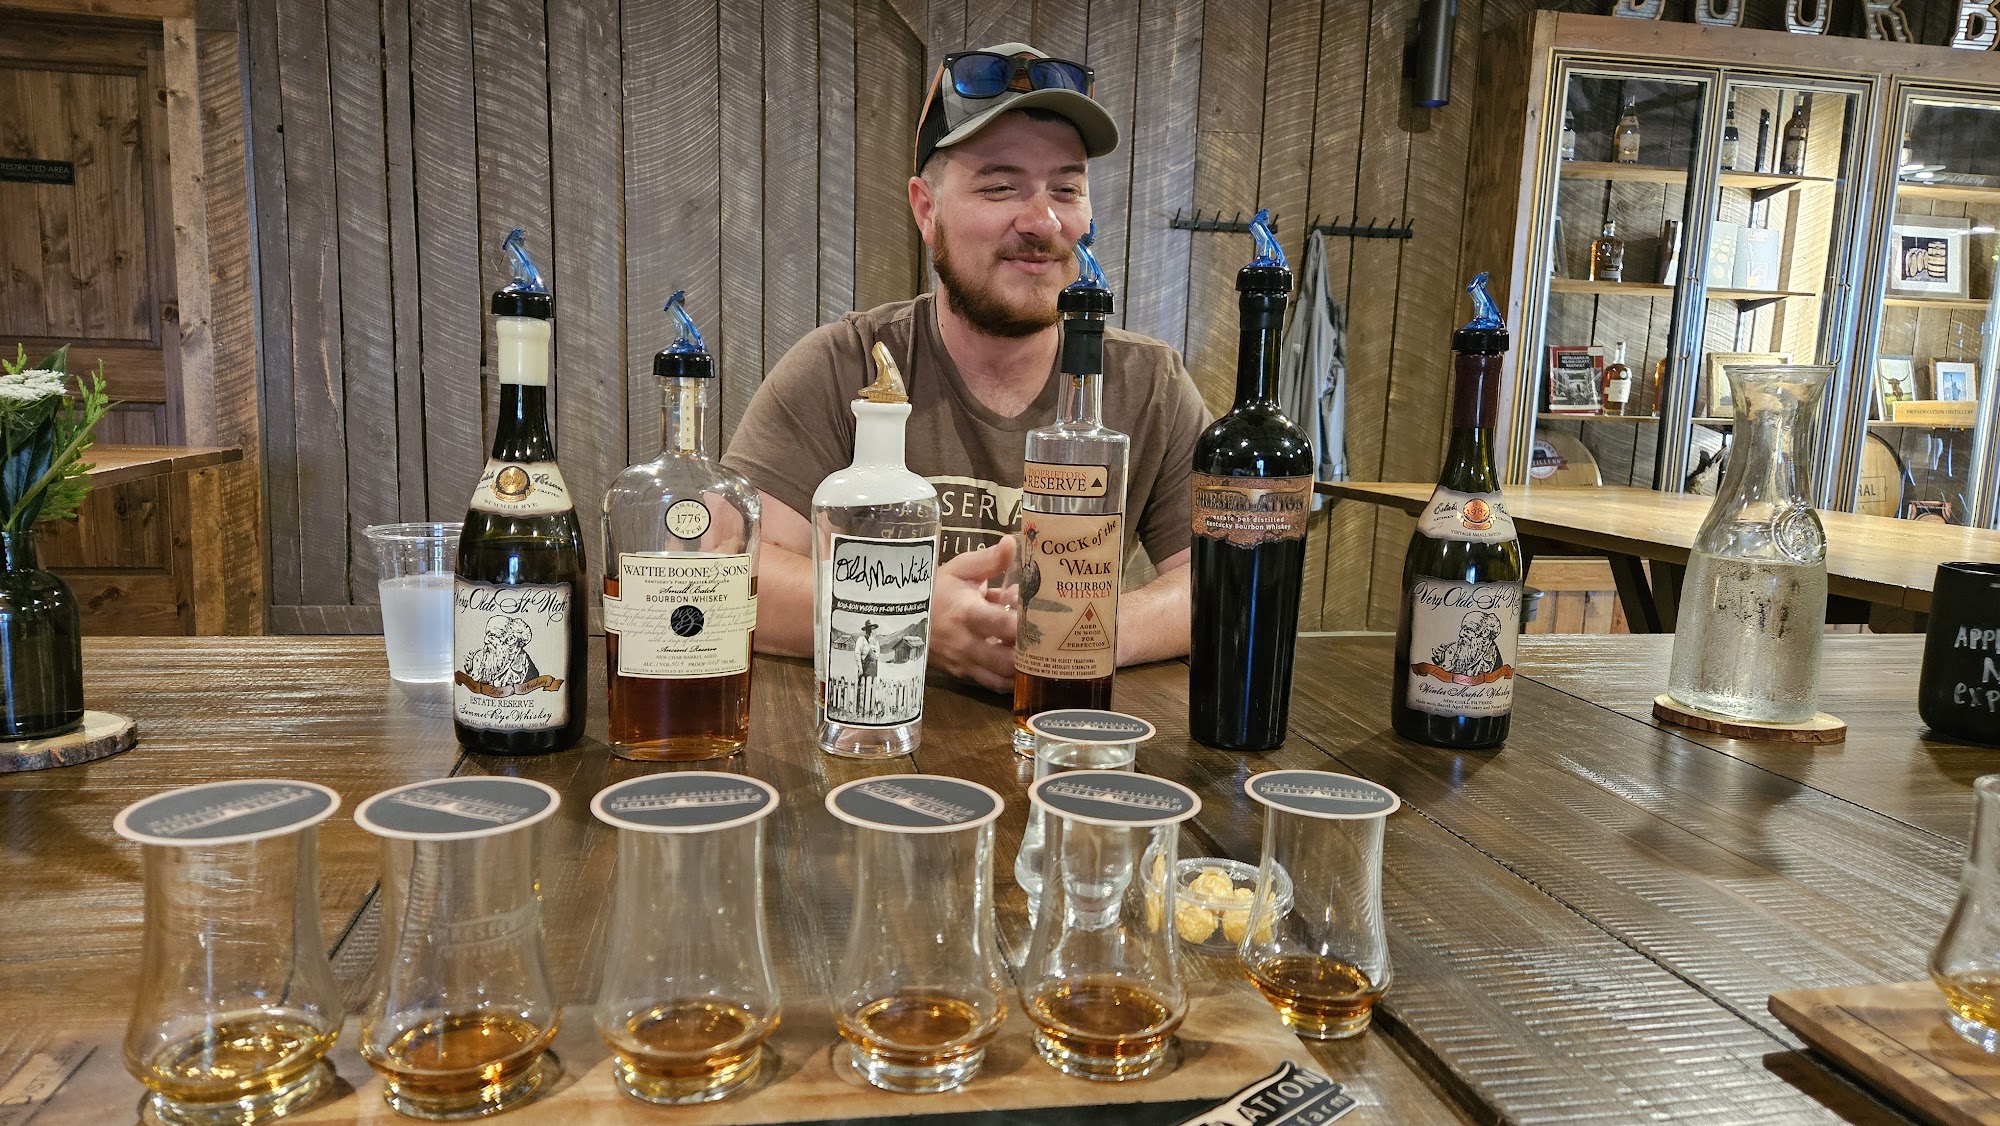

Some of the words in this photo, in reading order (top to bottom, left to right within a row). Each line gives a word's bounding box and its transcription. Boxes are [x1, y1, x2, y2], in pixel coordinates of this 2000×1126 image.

[0, 163, 47, 173] RESTRICTED
[48, 166, 70, 174] AREA
[1028, 475, 1087, 492] RESERVE
[484, 499, 520, 509] SUMMER
[675, 502, 701, 511] SMALL
[676, 513, 701, 524] 1776
[1237, 516, 1250, 524] pot
[675, 524, 702, 535] BATCH
[1206, 520, 1233, 530] Kentucky
[1234, 522, 1264, 531] Bourbon
[1265, 523, 1292, 531] Whiskey
[1092, 528, 1102, 546] of
[1104, 520, 1117, 537] the
[623, 564, 666, 577] WATTIE
[667, 566, 710, 578] BOONE
[722, 564, 748, 577] SONS
[836, 556, 868, 587] Old
[869, 560, 902, 592] Man
[659, 583, 692, 594] Small
[690, 582, 720, 594] Batch
[1056, 580, 1113, 591] BOURBON
[646, 594, 689, 603] BOURBON
[691, 594, 729, 603] WHISKEY
[1057, 588, 1112, 599] WHISKEY
[1413, 581, 1443, 610] Very
[1443, 587, 1474, 609] Olde
[469, 588, 497, 613] Olde
[494, 588, 532, 614] St.
[1419, 682, 1447, 695] Winter
[470, 696, 497, 707] ESTATE
[498, 700, 535, 708] RESERVE
[487, 708, 511, 724] Rye
[510, 707, 553, 722] Whiskey
